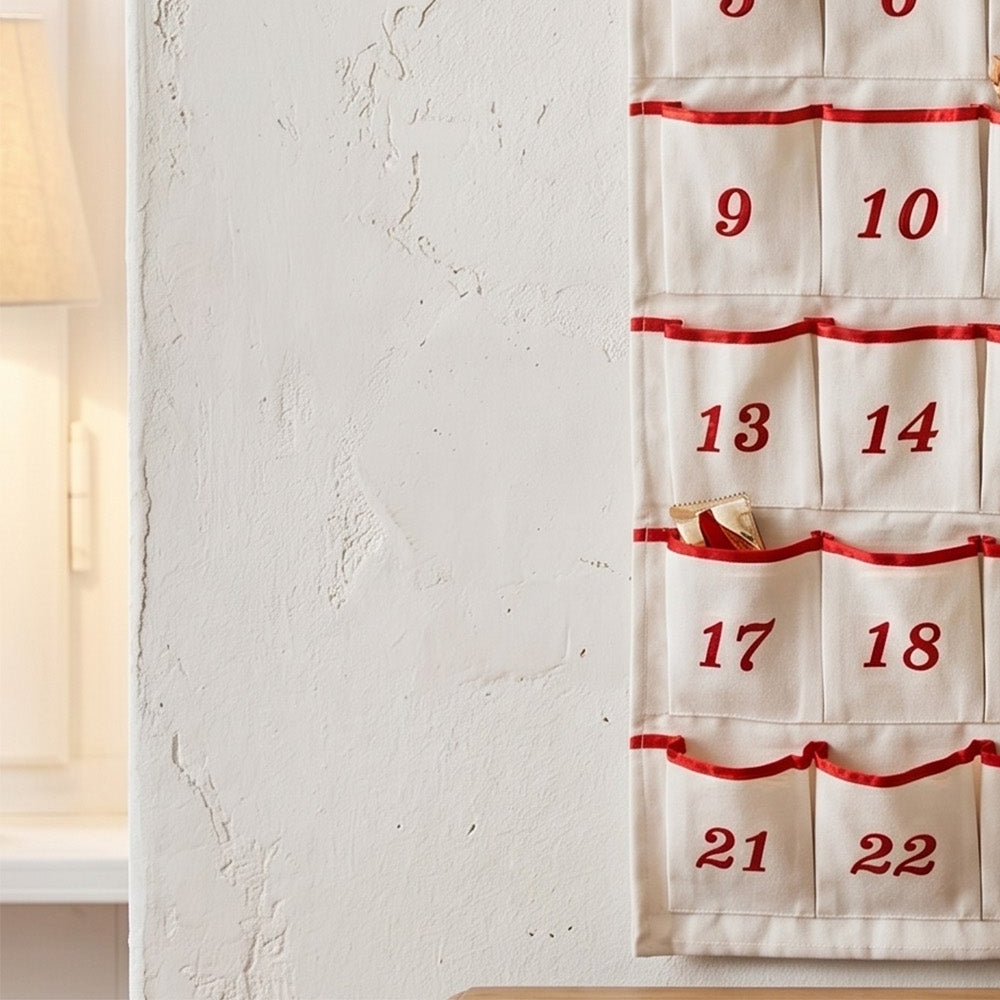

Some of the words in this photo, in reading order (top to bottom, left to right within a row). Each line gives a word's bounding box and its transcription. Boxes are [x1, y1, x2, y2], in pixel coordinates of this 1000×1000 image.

[716, 188, 751, 236] 9
[858, 188, 938, 239] 10
[697, 403, 770, 452] 13
[862, 402, 938, 453] 14
[700, 618, 775, 671] 17
[864, 622, 940, 670] 18
[696, 828, 767, 871] 21
[851, 834, 936, 876] 22
